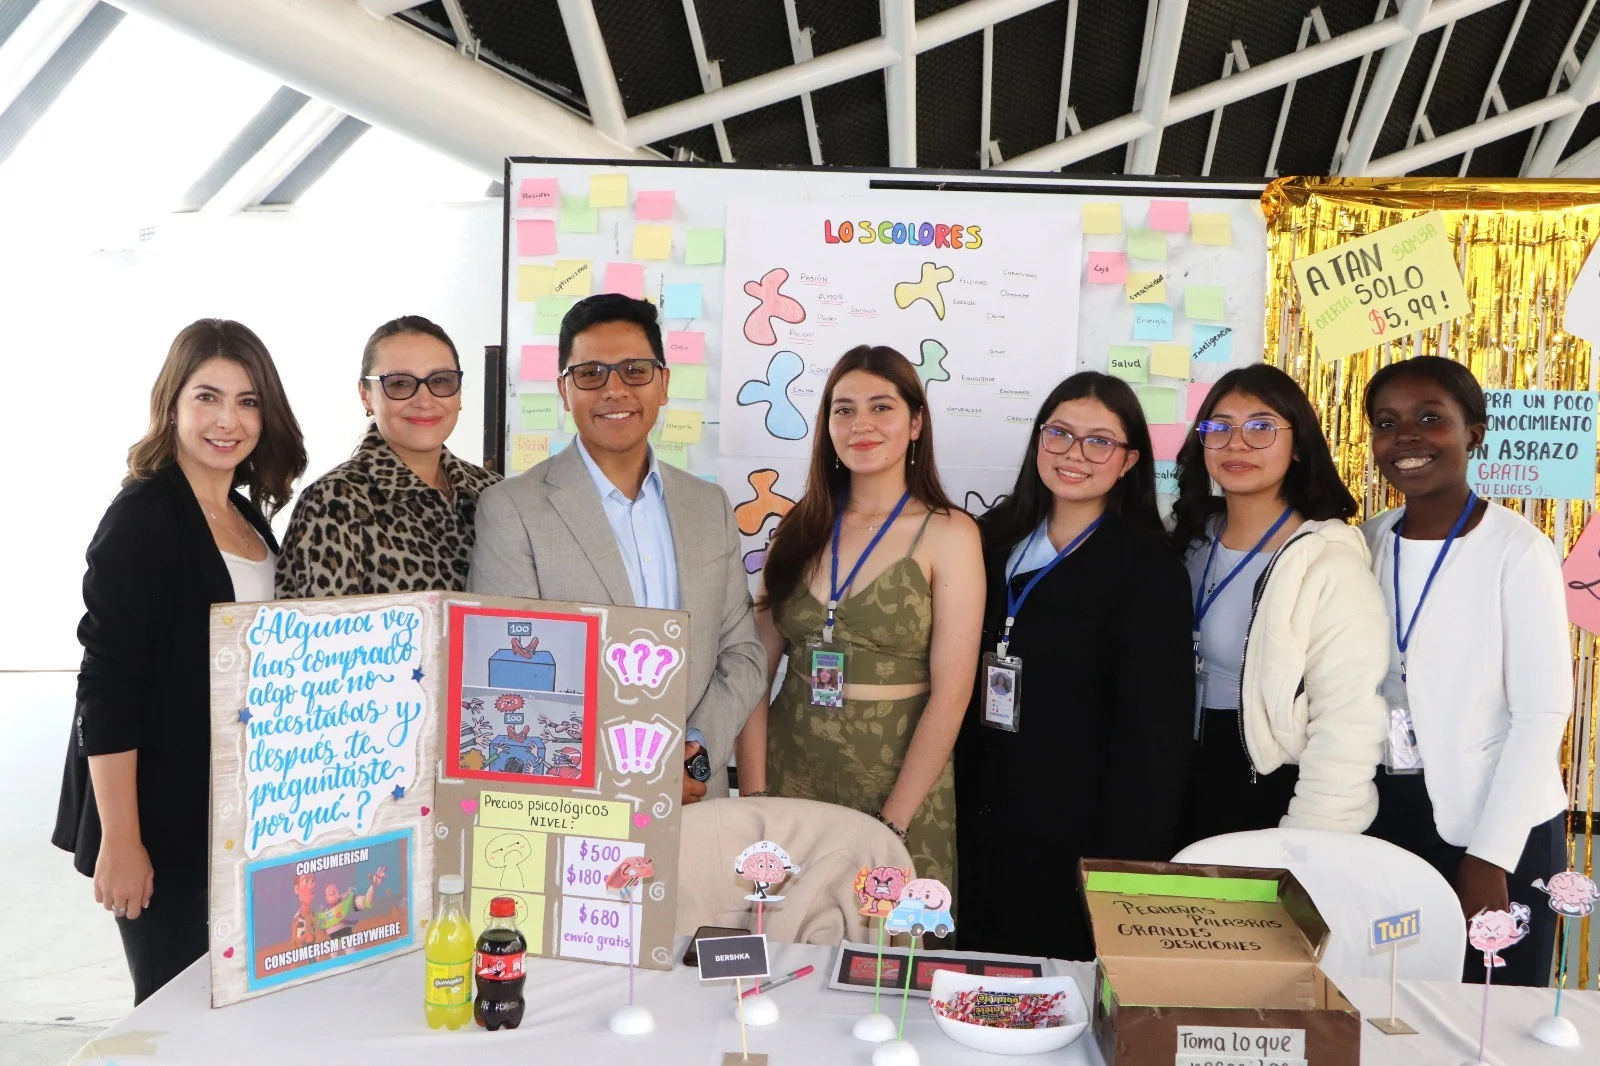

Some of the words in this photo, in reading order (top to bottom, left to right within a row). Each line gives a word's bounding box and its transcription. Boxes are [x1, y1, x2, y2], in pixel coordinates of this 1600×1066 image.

[1391, 222, 1438, 262] BOMBA
[1306, 266, 1331, 296] A
[1327, 242, 1383, 286] TAN
[1354, 265, 1424, 305] SOLO
[1315, 296, 1354, 330] OFERTA
[1192, 327, 1233, 360] Inteligencia
[1111, 359, 1142, 369] Salud
[1485, 392, 1512, 409] PRA
[1523, 394, 1545, 409] UN
[1554, 394, 1594, 412] POCO
[1486, 414, 1592, 432] ONOCIMIENTO
[1498, 438, 1579, 460] ABRAZO
[1478, 462, 1539, 481] GRATIS
[1493, 483, 1532, 496] ELIGES
[250, 608, 373, 660] ¿Alguna
[380, 609, 420, 648] vez
[509, 624, 530, 634] 100
[252, 652, 297, 679] has
[302, 632, 417, 680] comprado
[249, 682, 299, 719] algo
[301, 679, 344, 714] que
[347, 670, 395, 693] no
[248, 699, 388, 739] necesitabas
[387, 701, 421, 748] y
[506, 714, 522, 722] 100
[249, 733, 338, 781] después
[344, 729, 385, 760] te
[249, 757, 405, 820] preguntaste
[484, 794, 524, 811] Precios
[528, 798, 609, 820] psicológicos
[250, 813, 293, 850] por
[296, 848, 369, 876] CONSUMERISM
[1113, 900, 1216, 915] PEQUEÑAS
[1117, 923, 1212, 938] GRANDES
[1186, 914, 1283, 929] PALABRAS
[1378, 914, 1417, 941] TuTi
[264, 940, 340, 971] CONSUMERISM
[340, 921, 401, 952] EVERYWHERE
[564, 931, 594, 944] envío
[596, 934, 631, 952] gratis
[1160, 938, 1262, 951] DESICIONES
[715, 952, 750, 962] BERSHKA
[1180, 1032, 1226, 1052] Toma
[1232, 1032, 1251, 1051] lo
[1255, 1035, 1291, 1058] que
